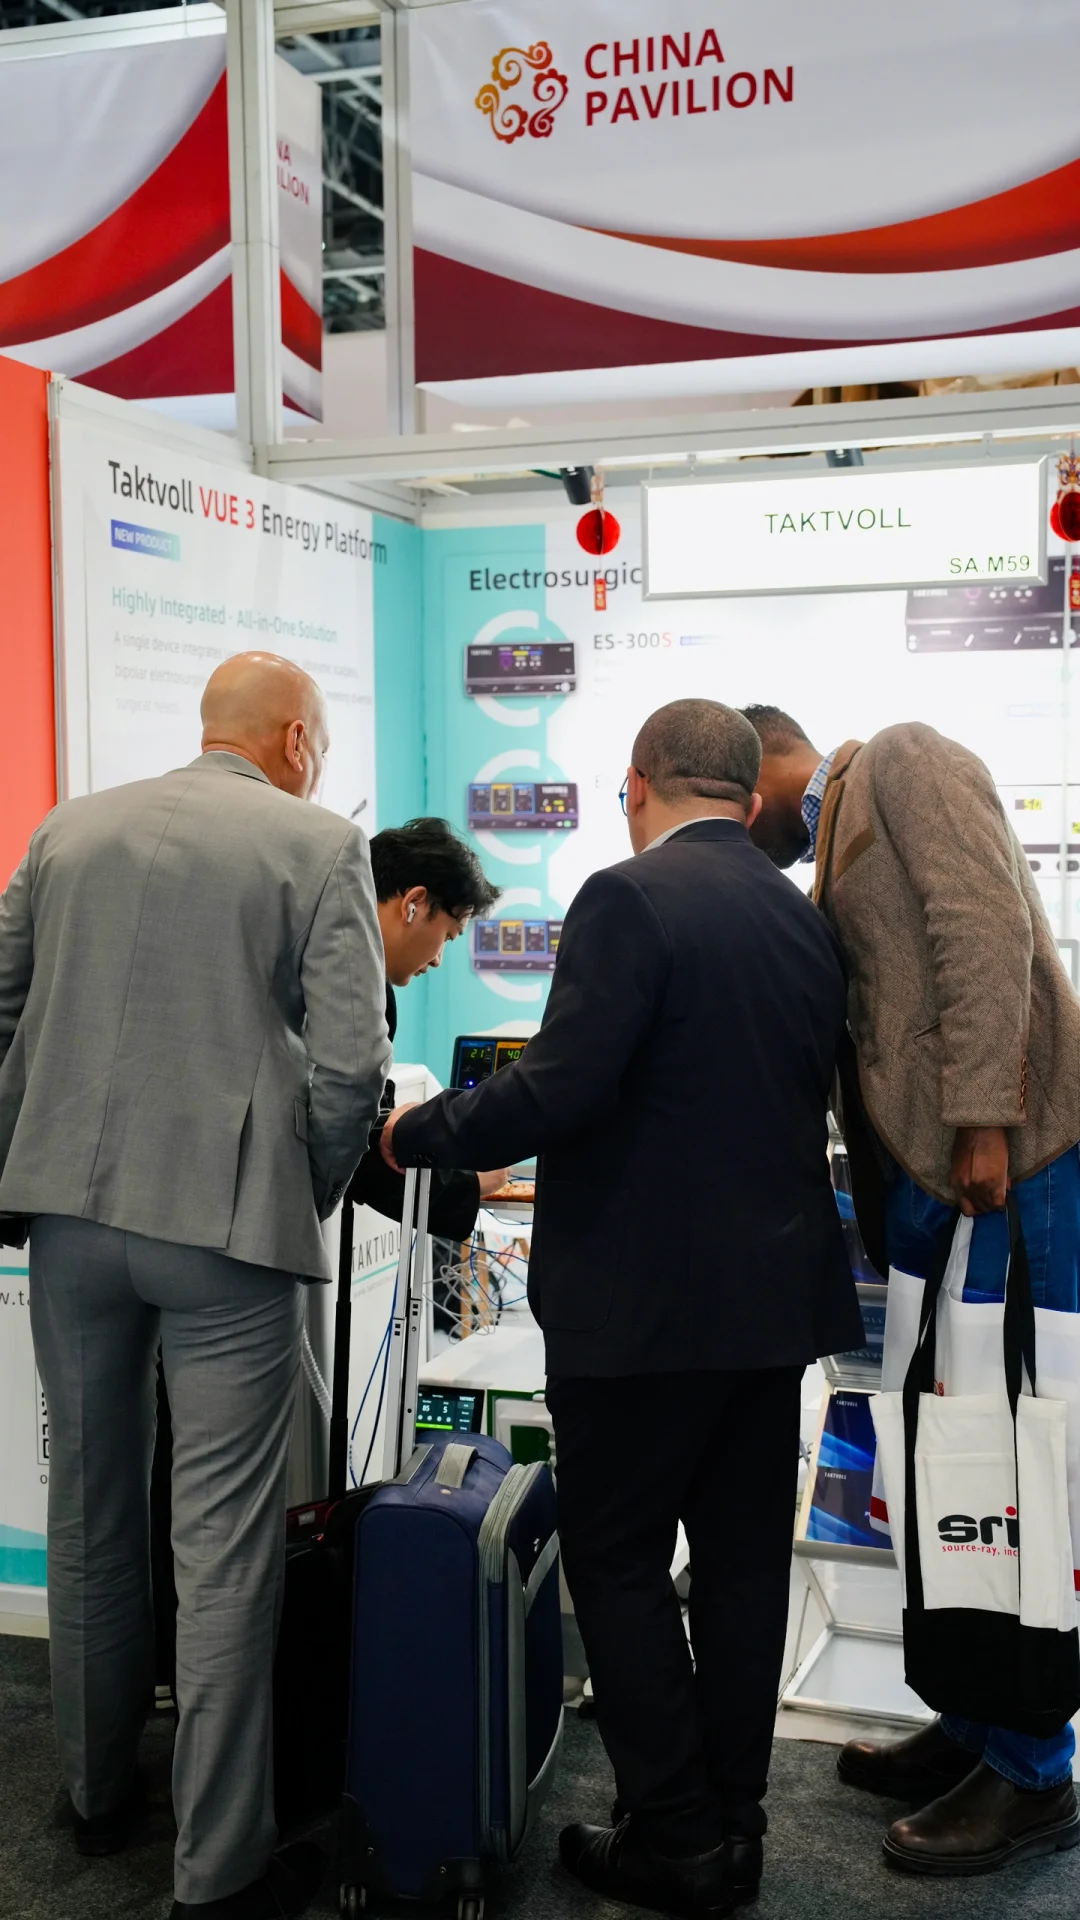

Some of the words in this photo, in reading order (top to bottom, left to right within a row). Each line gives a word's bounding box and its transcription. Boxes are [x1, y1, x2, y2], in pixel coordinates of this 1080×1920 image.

[584, 28, 725, 79] CHINA
[585, 66, 794, 126] PAVILION
[276, 164, 309, 205] ILION
[108, 460, 194, 515] Taktvoll
[199, 486, 239, 525] VUE
[246, 499, 255, 529] 3
[262, 504, 320, 552] Energy
[325, 522, 387, 565] Platform
[764, 507, 912, 534] TAKTVOLL
[114, 527, 134, 544] NEW
[135, 532, 172, 551] PRODUCT
[470, 562, 642, 591] Electrosurgic
[112, 586, 157, 614] Highly
[160, 596, 226, 625] Integrated
[237, 610, 296, 636] All-in-One
[298, 620, 338, 643] Solution
[593, 632, 672, 650] ES-300S
[470, 1049, 484, 1058] 21
[507, 1050, 521, 1059] 40
[352, 1228, 400, 1273] TAKTVOL
[937, 1506, 1019, 1549] sri
[942, 1544, 1000, 1556] source-ray,
